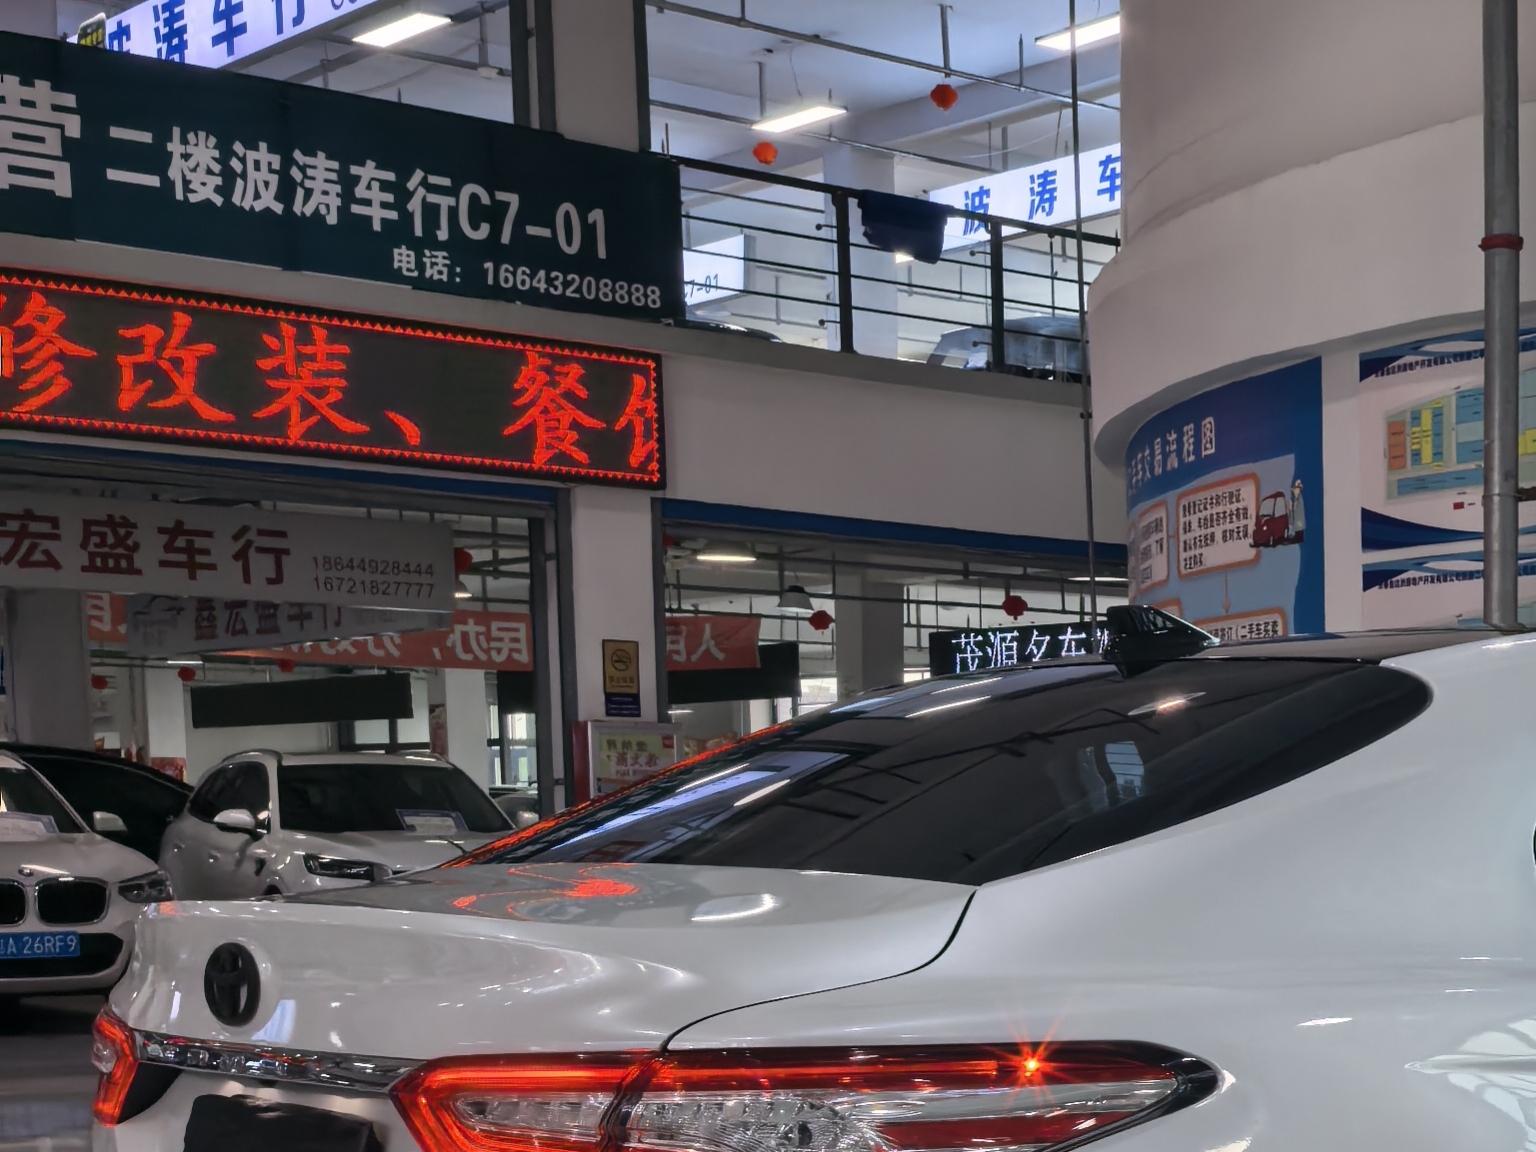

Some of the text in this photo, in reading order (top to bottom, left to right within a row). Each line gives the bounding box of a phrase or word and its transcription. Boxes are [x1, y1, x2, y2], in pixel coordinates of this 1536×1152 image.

[106, 126, 608, 260] 二楼波涛车行C7-01
[484, 261, 661, 308] 16643208888
[684, 274, 719, 298] 7-01
[0, 508, 291, 586] 宏盛车行
[23, 934, 78, 954] 26RF9
